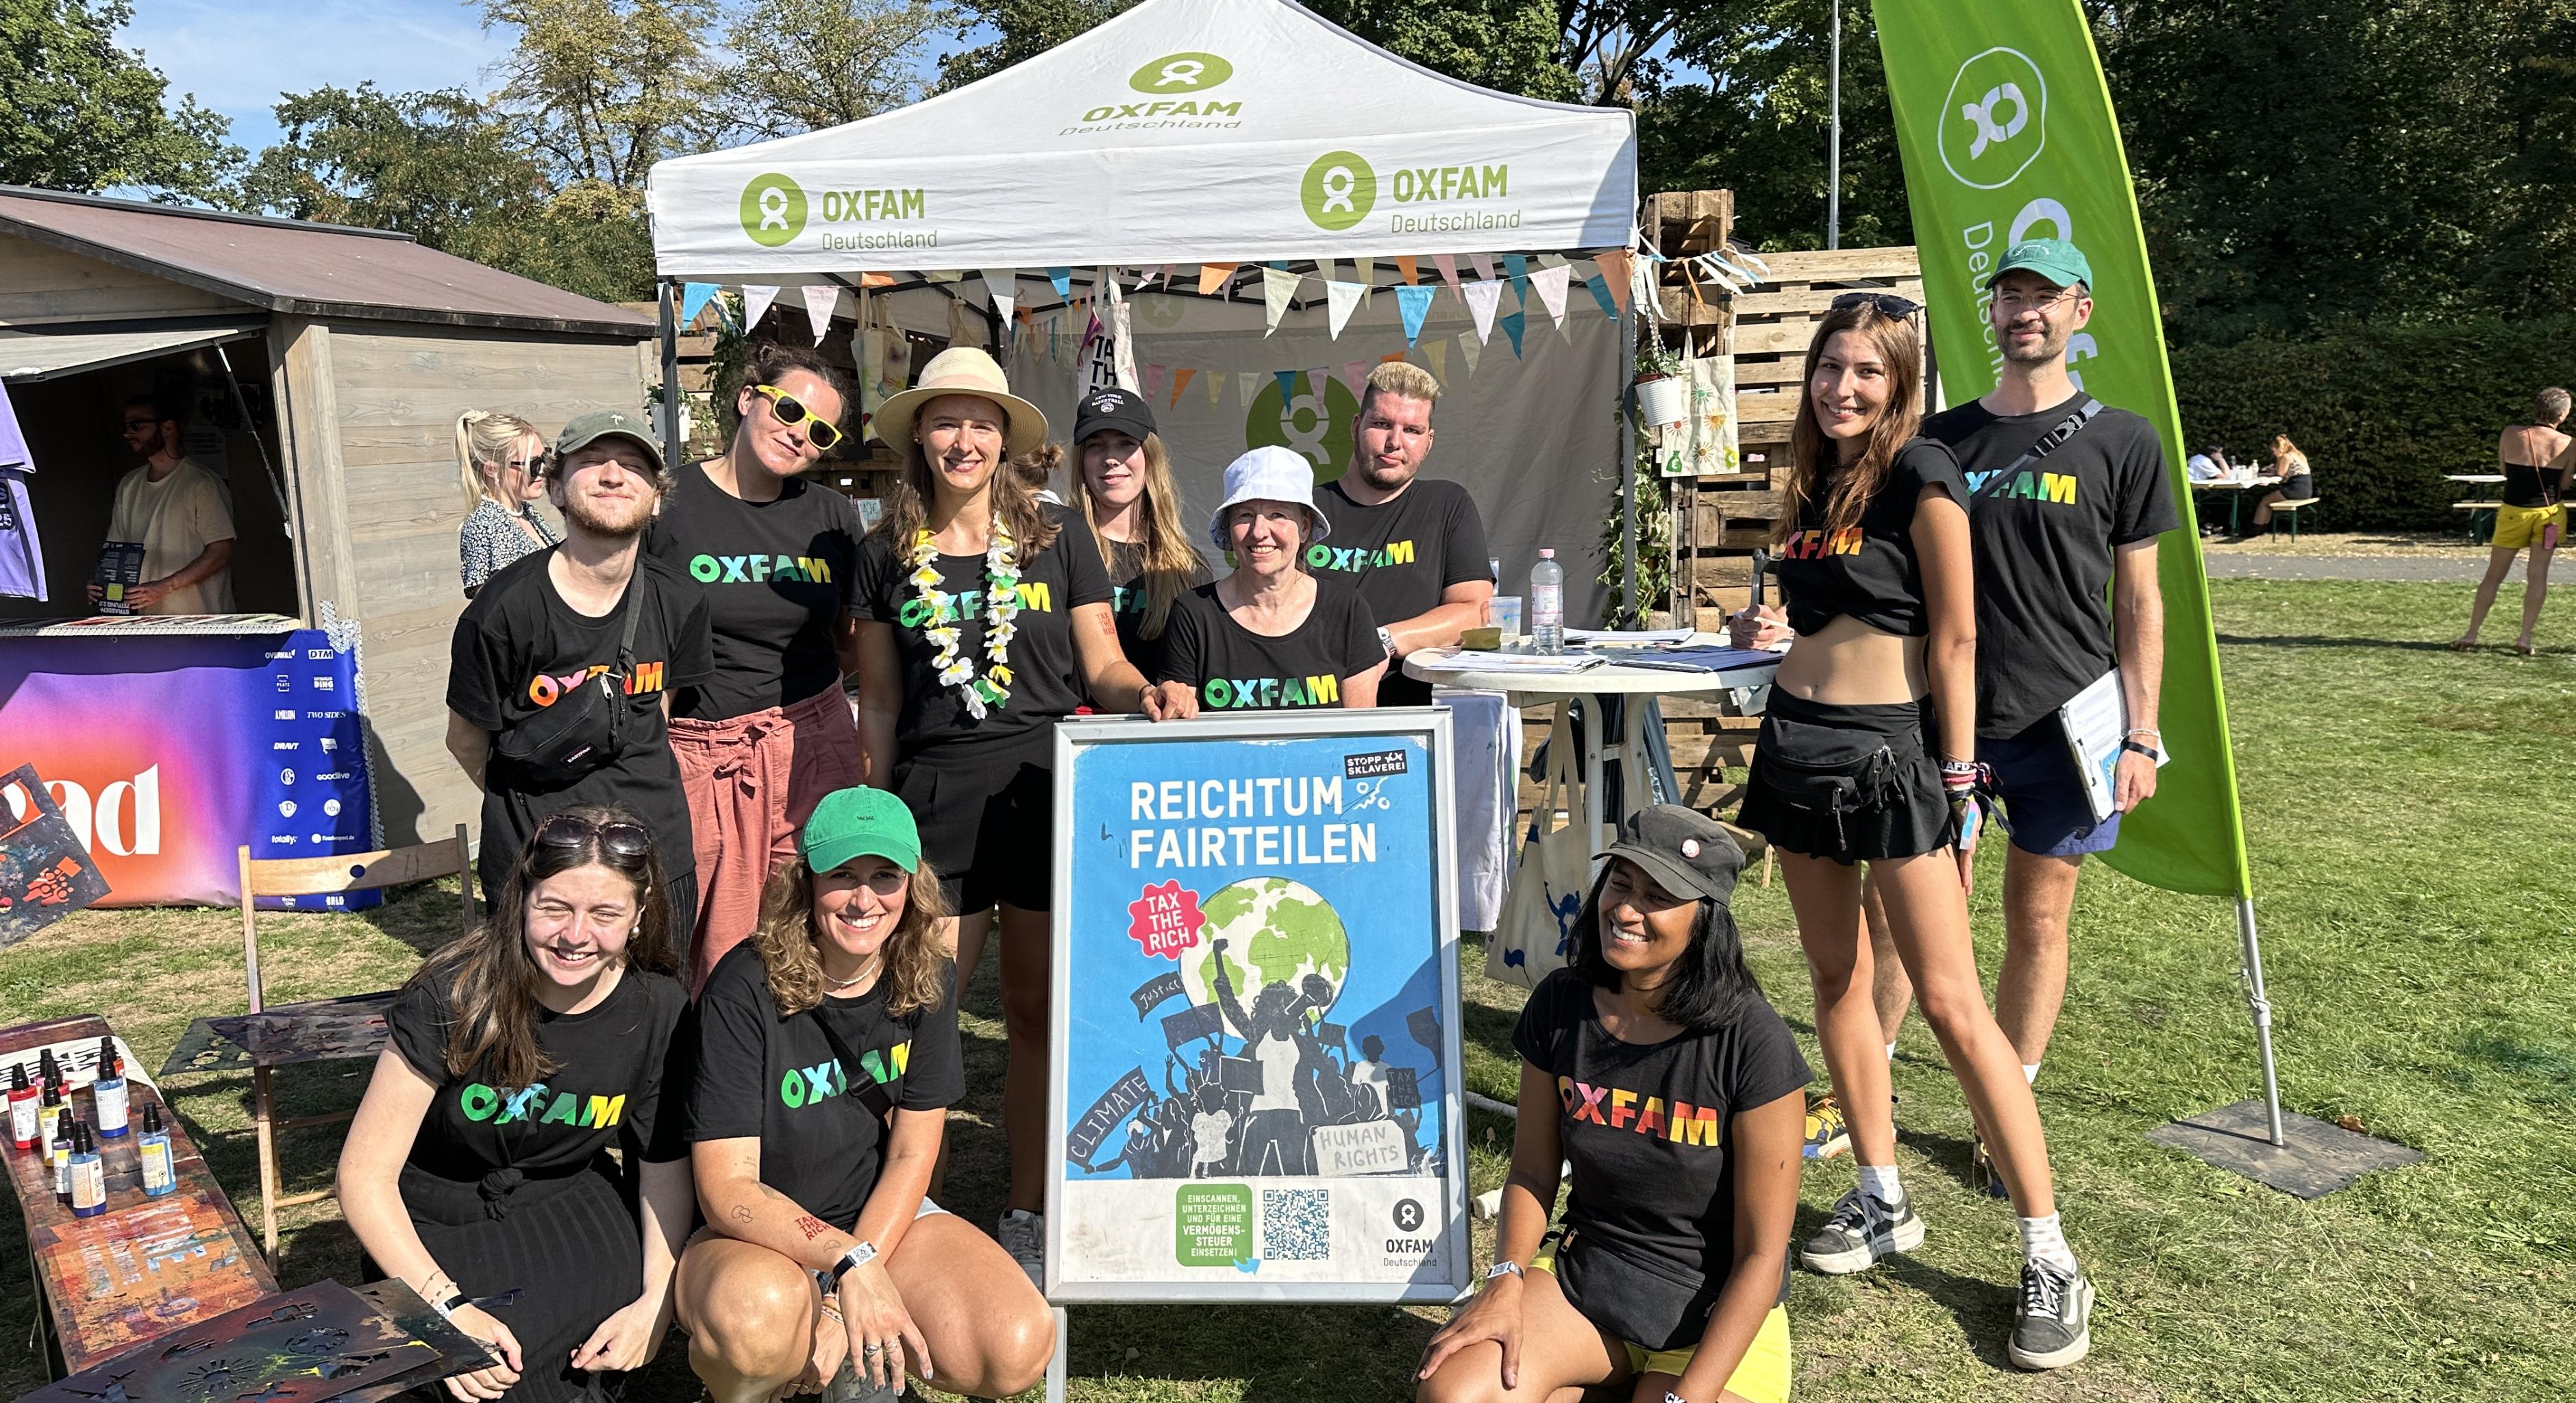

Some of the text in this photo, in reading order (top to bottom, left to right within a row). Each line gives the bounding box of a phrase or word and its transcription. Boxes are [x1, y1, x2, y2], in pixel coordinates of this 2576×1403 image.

[1082, 101, 1242, 122] OXFAM
[1058, 120, 1242, 136] Deutschland
[1393, 164, 1508, 203] OXFAM
[822, 188, 925, 223] OXFAM
[1391, 209, 1521, 233] Deutschland
[822, 230, 938, 251] Deutschland
[1306, 540, 1415, 573] OXFAM
[689, 554, 832, 583] OXFAM
[1204, 674, 1339, 708] OXFAM
[567, 746, 591, 762] EASTPAK
[1347, 756, 1382, 767] STOPP
[1348, 762, 1405, 775] SKLAVEREI
[1946, 762, 1970, 771] AFD
[1130, 776, 1343, 820] REICHTUM
[1130, 823, 1376, 869] FAIRTEILEN
[1146, 891, 1181, 913] TAX
[1148, 910, 1185, 932] THE
[1149, 927, 1191, 951] RICH
[1389, 1071, 1411, 1083] TAX
[1390, 1083, 1414, 1095] THE
[461, 1083, 626, 1129] OXFAM
[1391, 1095, 1418, 1107] RICH
[1071, 1073, 1150, 1158] CLIMATE
[1558, 1076, 1718, 1147] OXFAM
[1320, 1127, 1387, 1150] HUMAN
[1335, 1145, 1400, 1169] RIGHTS
[1187, 1194, 1240, 1204] EINSCANNEN,
[1182, 1204, 1246, 1213] UNTERZEICHNEN
[794, 1216, 816, 1226] TAX
[800, 1219, 821, 1232] THE
[1187, 1213, 1242, 1223] UND FÜR EINE
[806, 1224, 831, 1241] RICH
[1182, 1223, 1246, 1236] VERMÖGENS-
[1196, 1237, 1233, 1247] STEUER
[1386, 1239, 1433, 1253] OXFAM
[1191, 1247, 1237, 1257] EINSETZEN!
[1383, 1258, 1437, 1267] Deutschland
